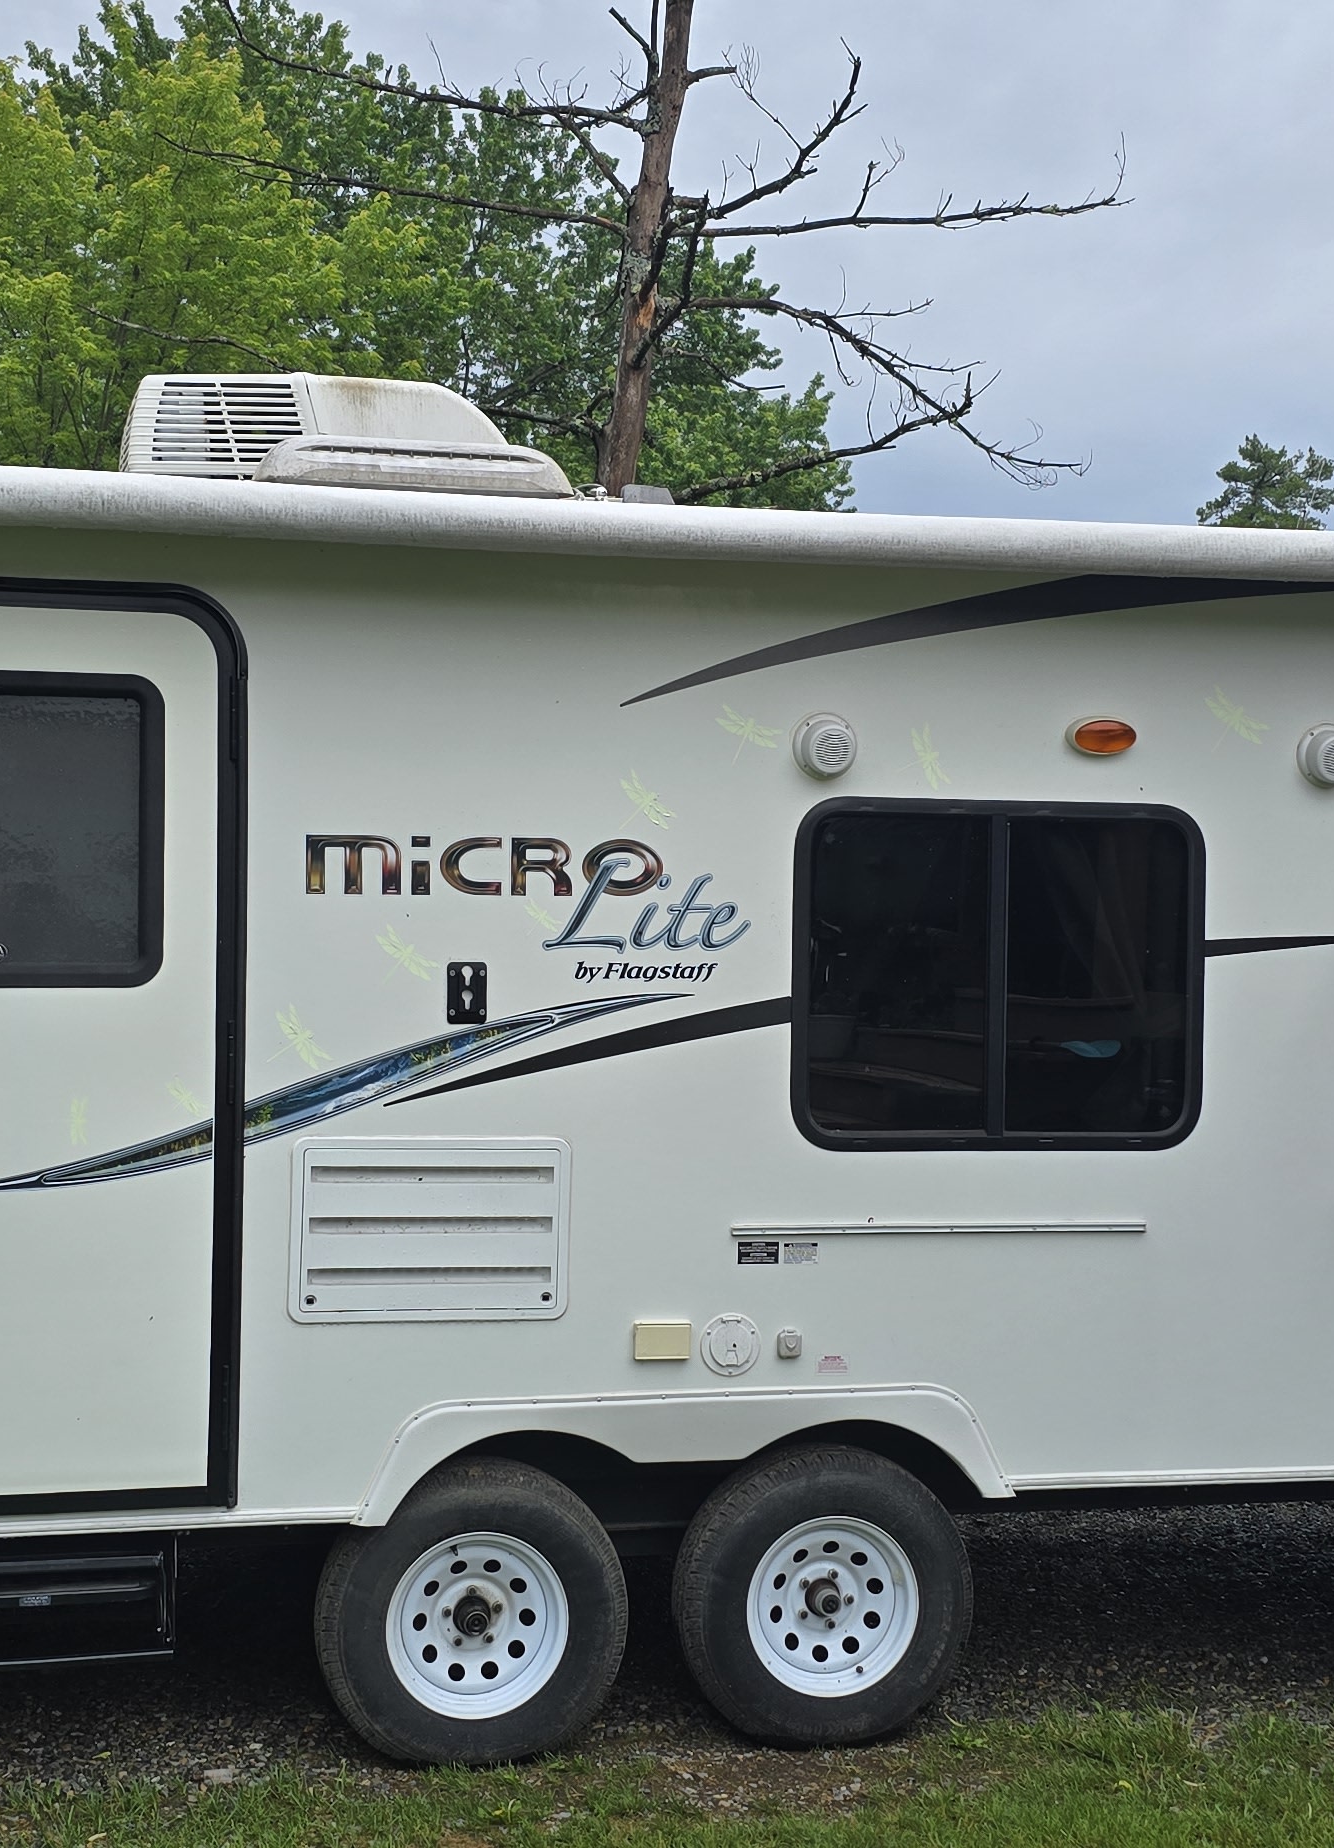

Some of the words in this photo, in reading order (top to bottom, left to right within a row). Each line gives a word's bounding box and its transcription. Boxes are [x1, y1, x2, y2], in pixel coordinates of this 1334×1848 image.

[542, 857, 752, 954] Lite
[574, 962, 603, 983] by
[603, 962, 718, 983] Flagstaff
